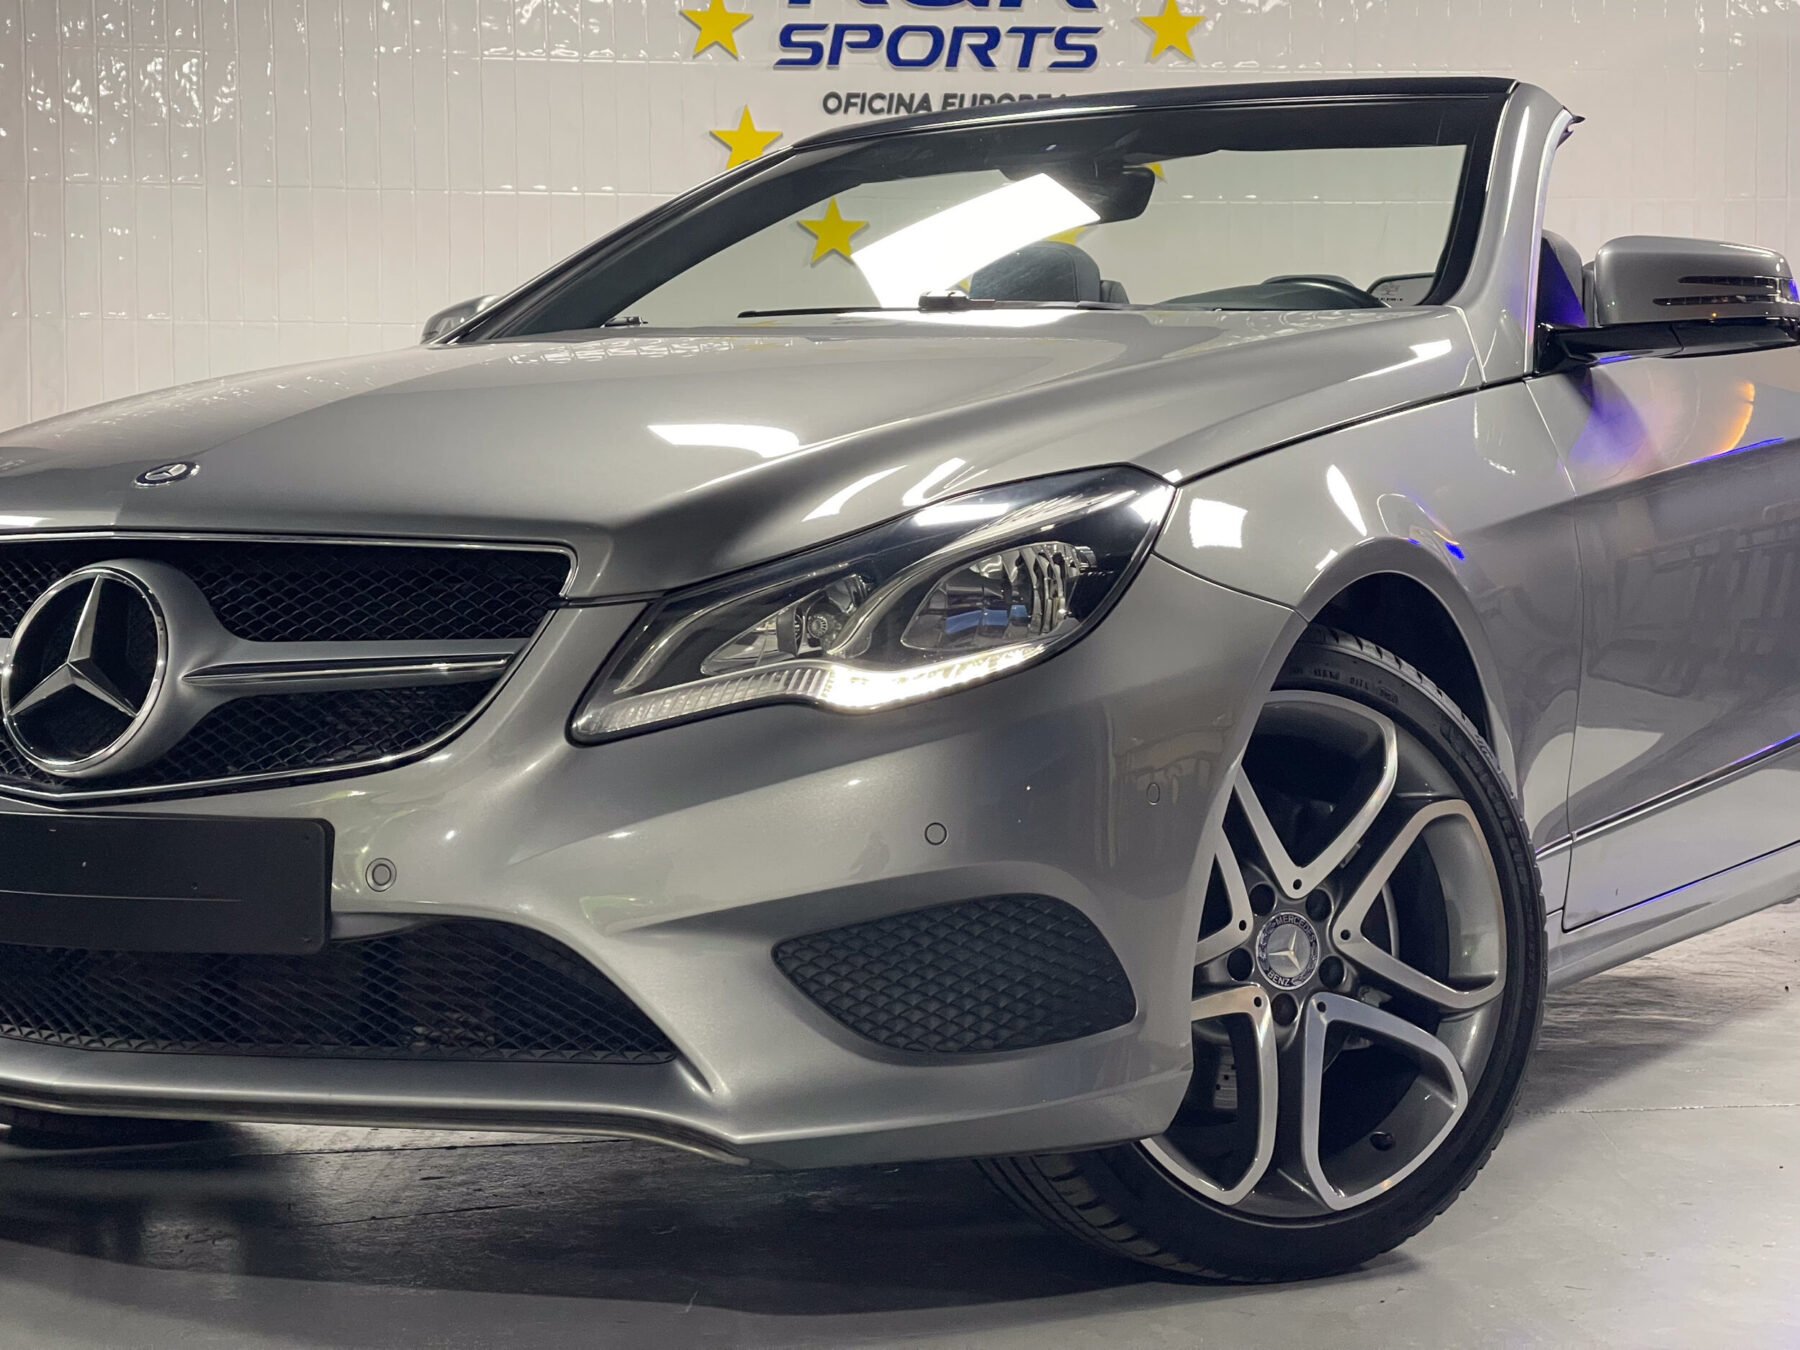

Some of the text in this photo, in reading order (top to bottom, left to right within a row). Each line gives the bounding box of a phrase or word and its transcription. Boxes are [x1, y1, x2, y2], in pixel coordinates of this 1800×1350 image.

[774, 24, 1103, 70] SPORTS
[822, 91, 932, 115] OFICINA
[1275, 915, 1316, 943] MERCEDES
[1267, 970, 1291, 986] BENZ
